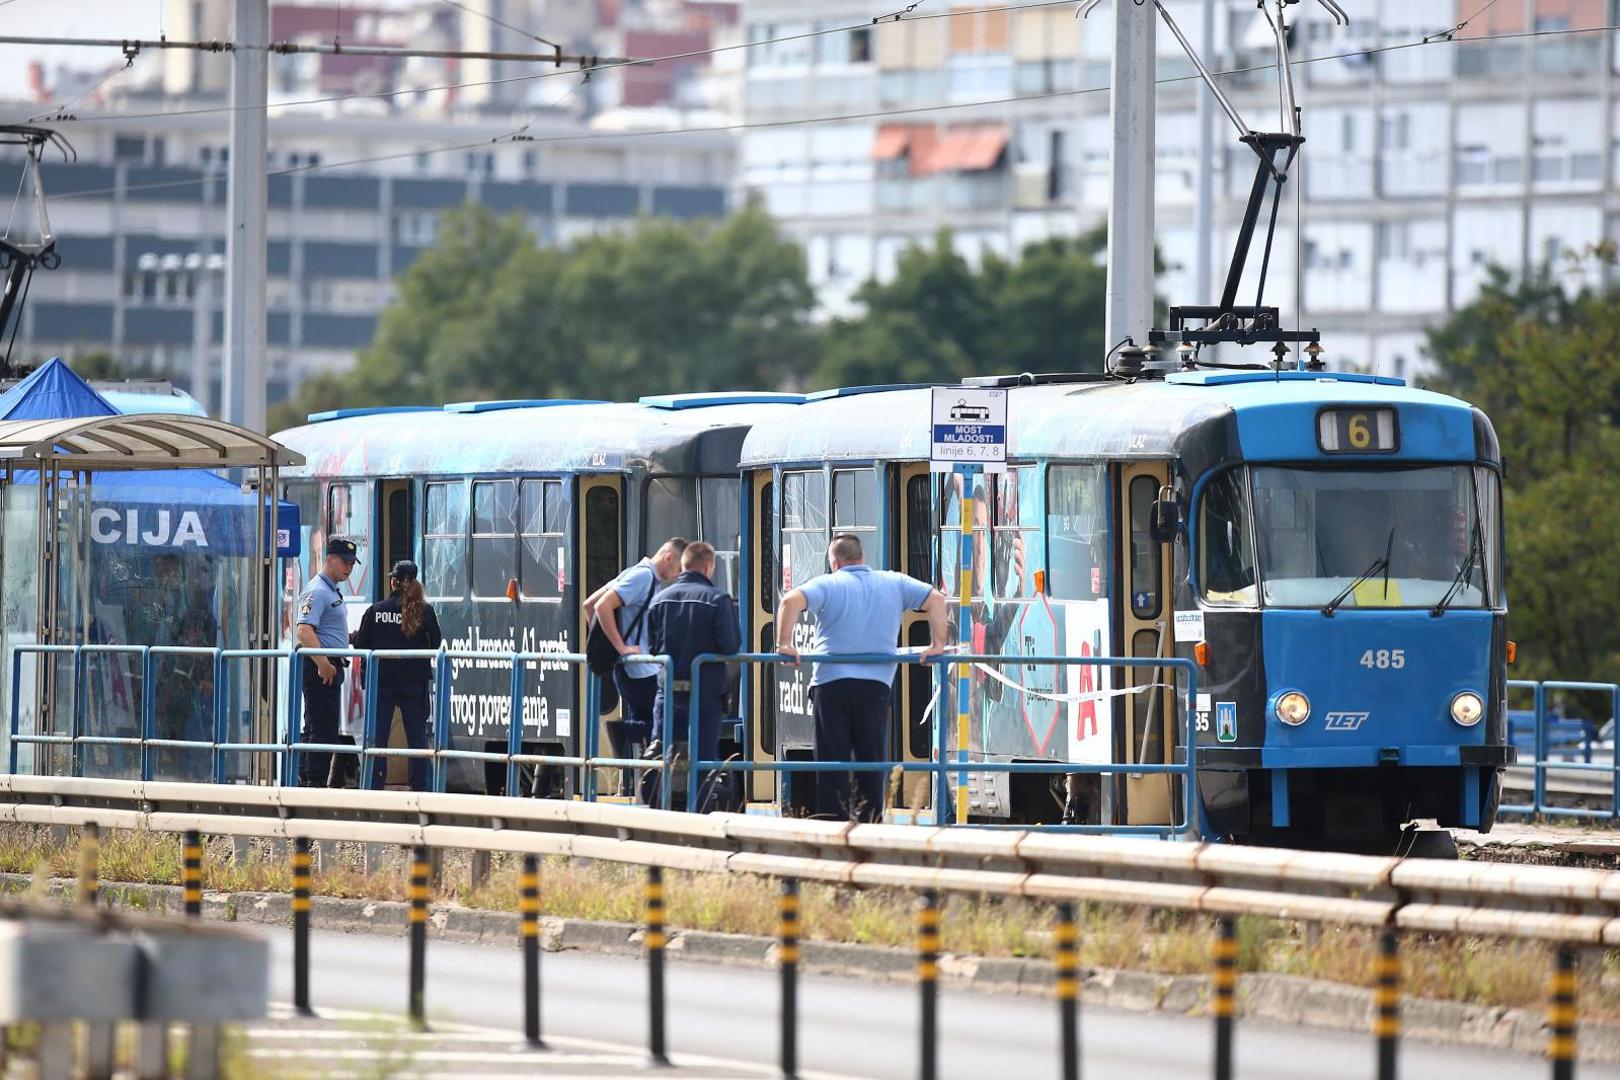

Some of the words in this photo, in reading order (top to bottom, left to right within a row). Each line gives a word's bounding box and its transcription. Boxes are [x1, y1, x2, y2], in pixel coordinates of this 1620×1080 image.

[955, 426, 983, 434] MOST
[1349, 413, 1370, 448] 6
[940, 445, 964, 457] linije
[992, 447, 999, 456] 8
[375, 611, 403, 624] POLIC
[451, 626, 474, 680] god
[539, 629, 570, 681] prati
[1360, 649, 1405, 669] 485
[779, 669, 804, 715] radi
[450, 685, 477, 736] tvog
[1325, 712, 1370, 730] ZET
